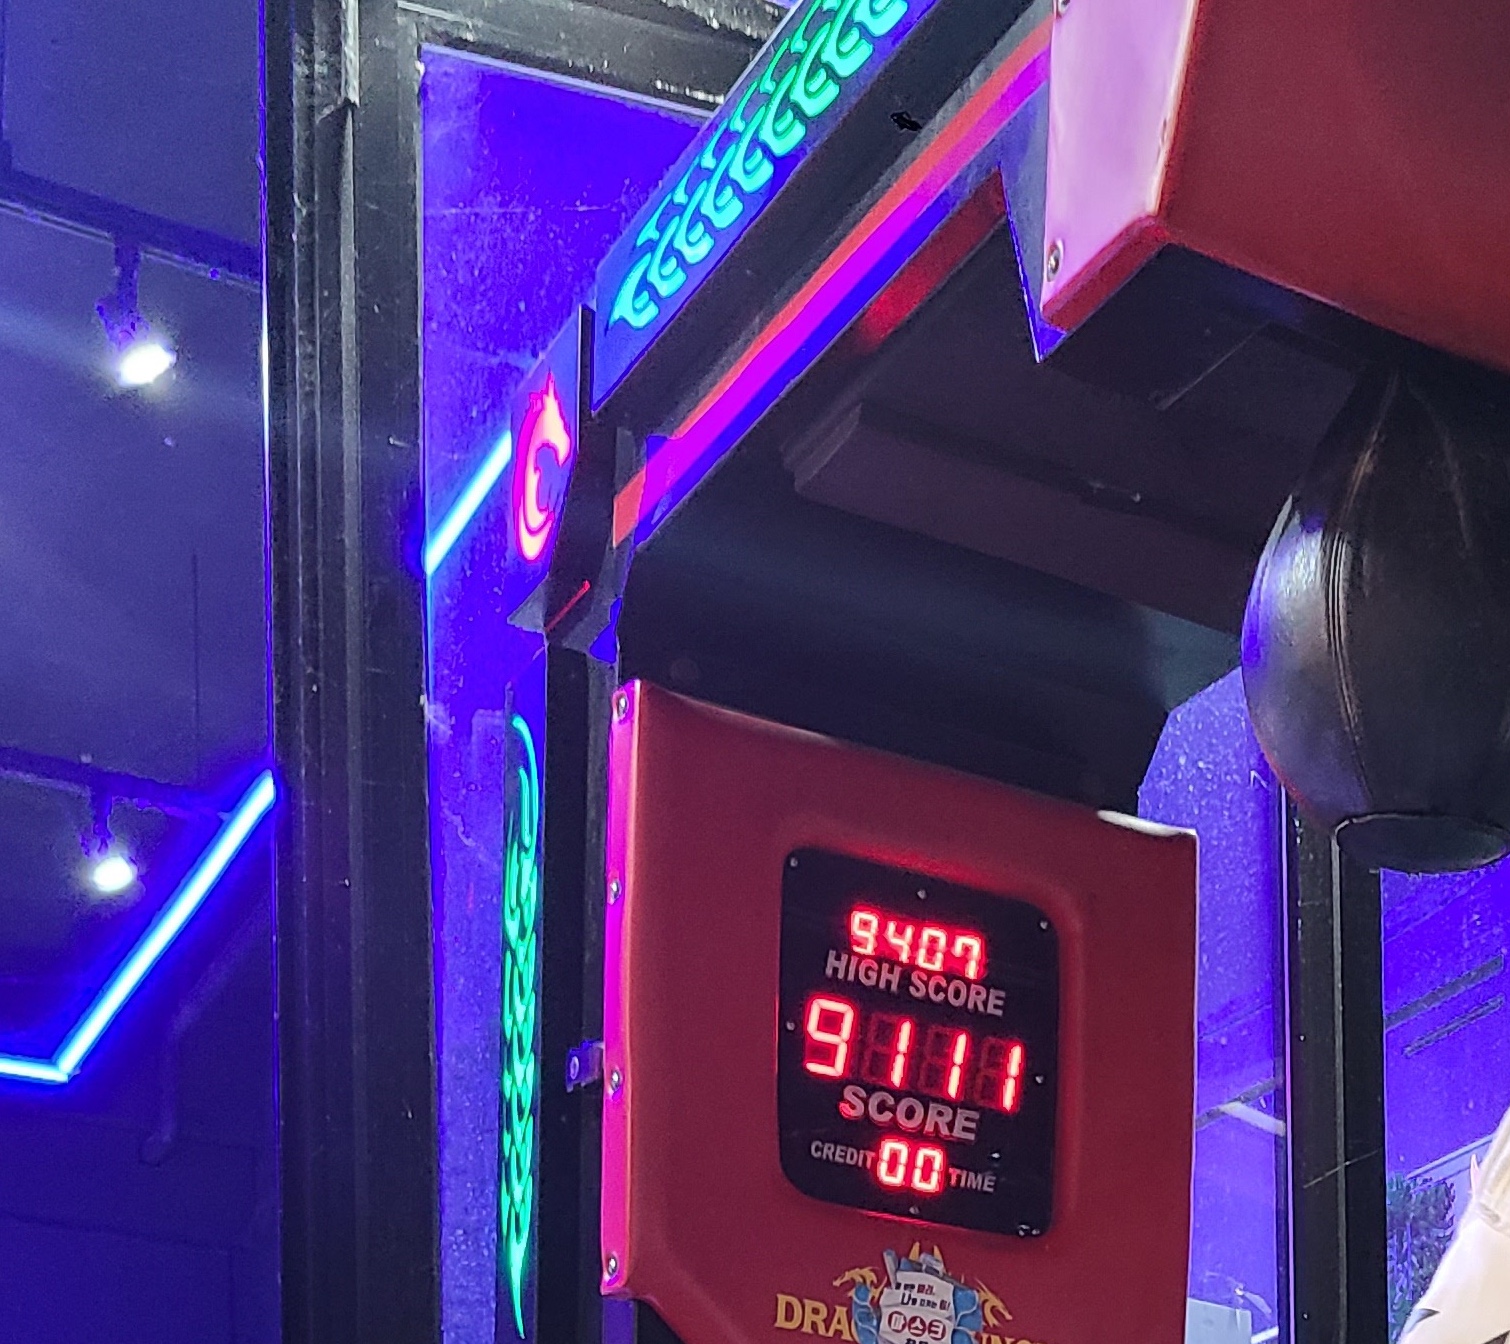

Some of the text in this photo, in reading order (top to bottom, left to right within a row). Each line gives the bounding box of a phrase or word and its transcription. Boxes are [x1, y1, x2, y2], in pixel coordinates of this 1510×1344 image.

[850, 909, 983, 980] 9407
[825, 950, 1006, 1017] HIGH SCORE
[805, 997, 1023, 1113] 9111
[840, 1084, 980, 1141] SCORE
[810, 1140, 876, 1169] CREDIT
[949, 1166, 997, 1193] TIME
[773, 1293, 857, 1342] DRA
